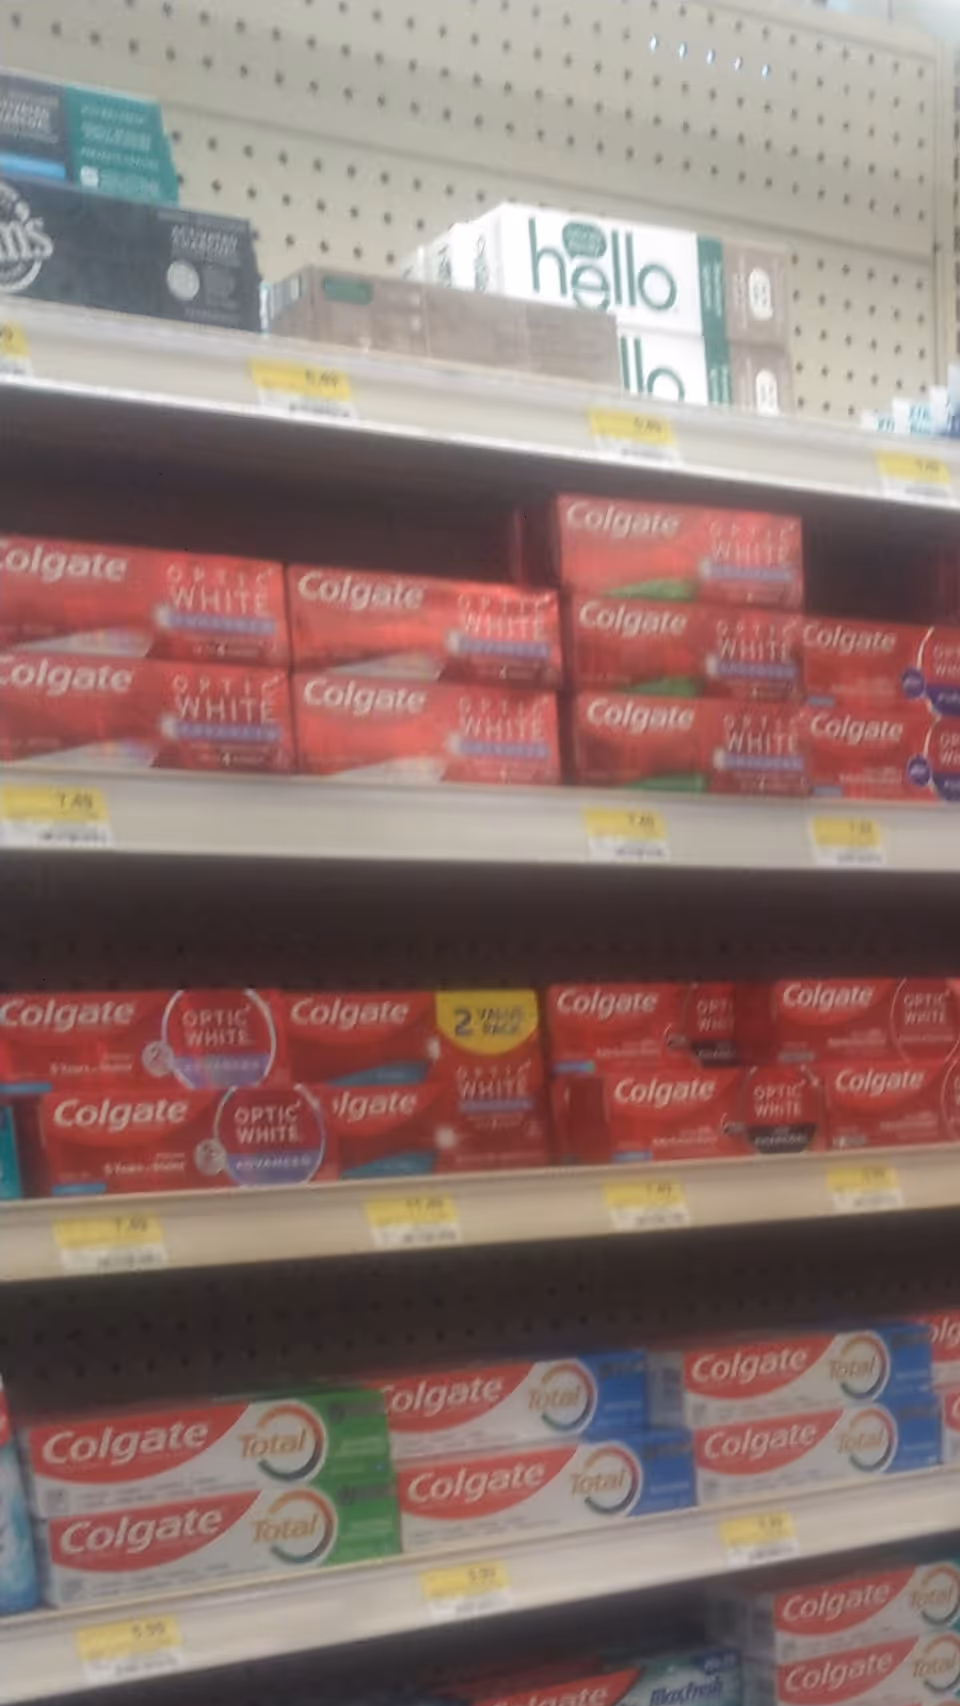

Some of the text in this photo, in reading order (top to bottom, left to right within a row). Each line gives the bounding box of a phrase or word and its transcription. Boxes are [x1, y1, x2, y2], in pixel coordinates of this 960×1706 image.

[528, 216, 678, 313] hello
[620, 335, 686, 402] llo
[566, 501, 681, 540] Colgate
[298, 570, 425, 611] Colgate
[579, 600, 687, 637] Colgate
[802, 622, 896, 654] Colgate
[303, 677, 427, 714] Colgate
[587, 696, 694, 736] Colgate
[809, 712, 903, 744] Colgate
[557, 988, 659, 1020] Colgate
[782, 983, 874, 1011] Colgate
[2, 997, 136, 1031] Colgate
[182, 1008, 251, 1028] OPTIC
[291, 997, 409, 1031] Colgate
[454, 1007, 473, 1037] 2
[185, 1025, 251, 1048] WHITE
[614, 1078, 716, 1107] Colgate
[835, 1069, 925, 1095] Colgate
[54, 1097, 189, 1133] Colgate
[234, 1104, 298, 1125] OPTIC
[332, 1088, 417, 1121] lgate
[235, 1125, 300, 1146] WHITE
[690, 1346, 808, 1383] Colgate
[828, 1353, 878, 1379] Total
[528, 1383, 581, 1410] Total
[41, 1421, 209, 1466] Colgate
[237, 1426, 307, 1460] Total
[703, 1423, 819, 1460] Colgate
[837, 1428, 885, 1454] Total
[407, 1459, 546, 1502] Colgate
[570, 1469, 627, 1496] Total
[60, 1505, 223, 1555] Colgate
[252, 1513, 320, 1545] Total
[782, 1580, 891, 1622] Colgate
[910, 1584, 956, 1609] Total
[785, 1651, 893, 1694] Colgate
[912, 1652, 960, 1680] Total
